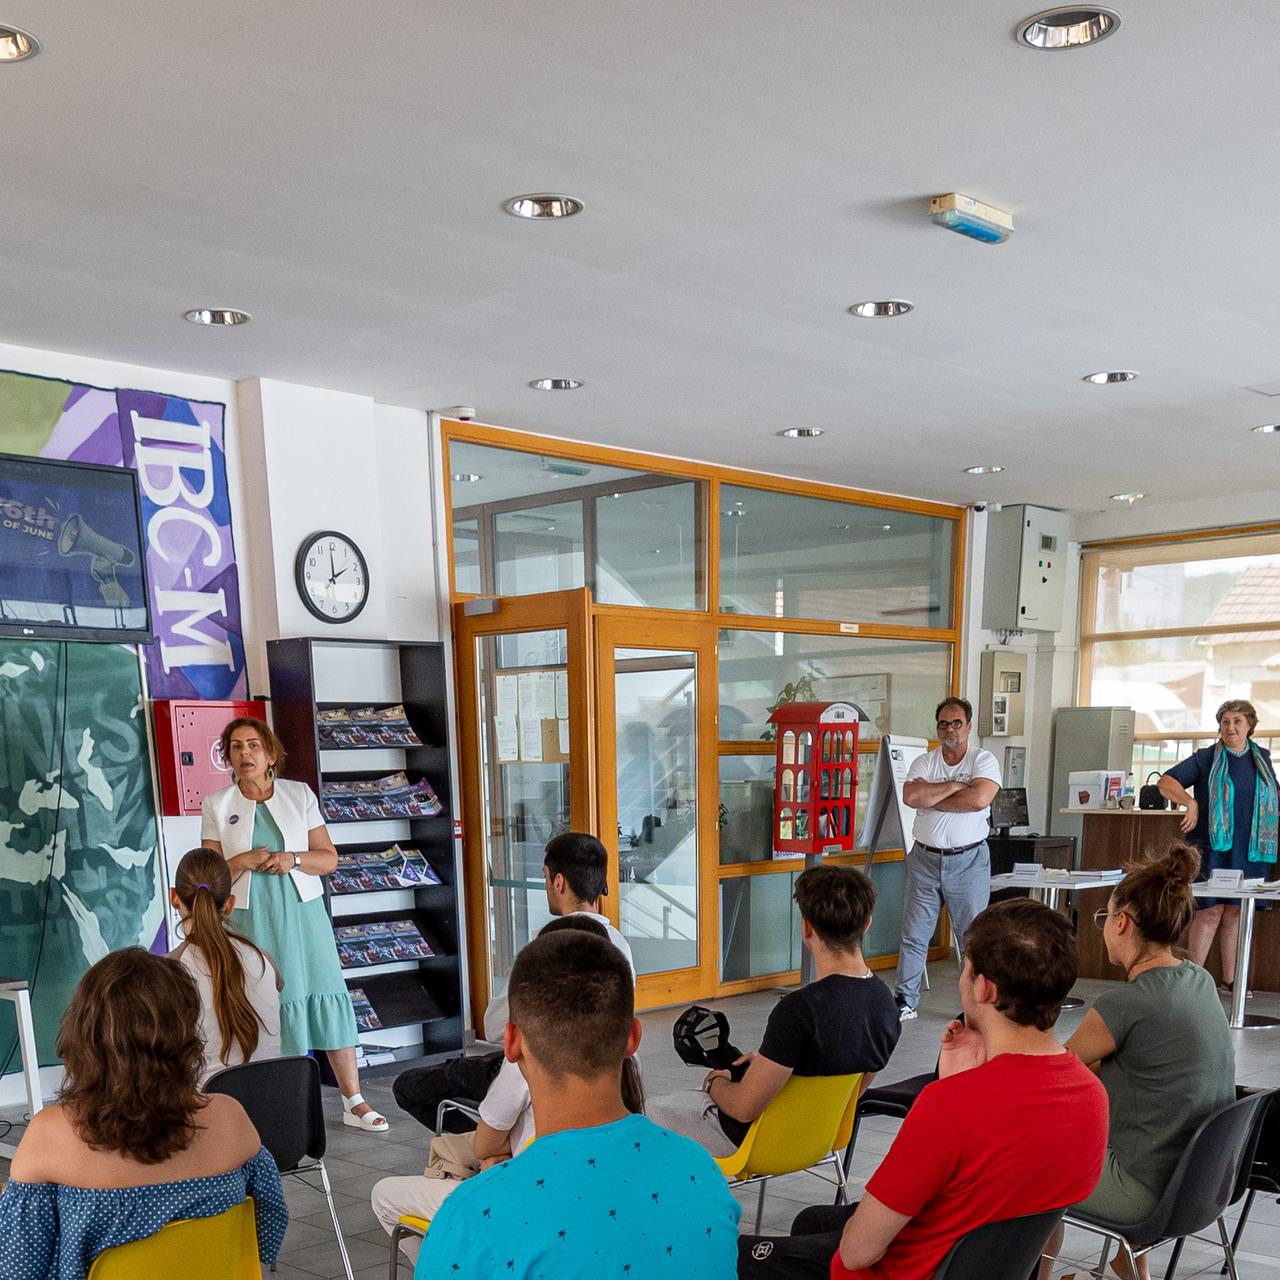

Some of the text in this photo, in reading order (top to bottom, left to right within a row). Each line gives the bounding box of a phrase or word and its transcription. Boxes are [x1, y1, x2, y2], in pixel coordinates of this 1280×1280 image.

[3, 519, 54, 541] OF JUNE
[130, 410, 236, 674] IBC-M
